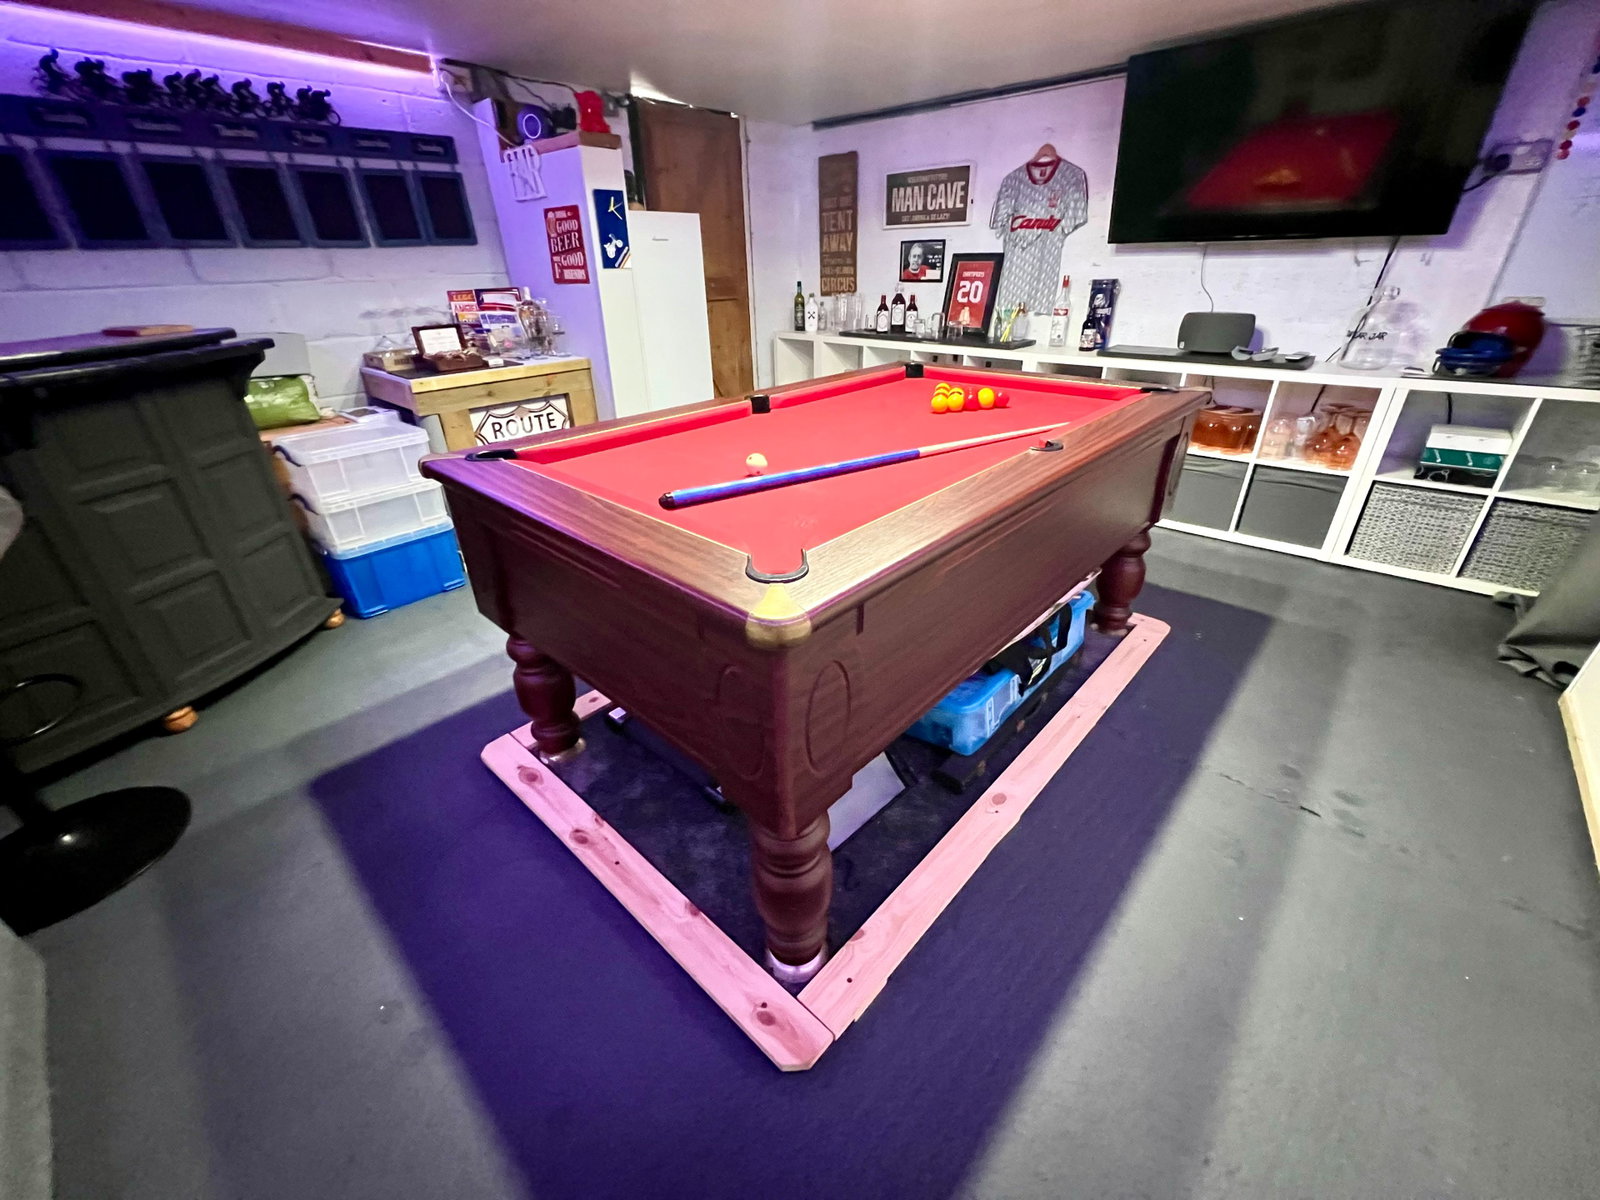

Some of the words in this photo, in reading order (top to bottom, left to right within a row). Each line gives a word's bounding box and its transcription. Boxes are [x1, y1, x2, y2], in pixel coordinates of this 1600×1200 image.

[892, 184, 924, 213] MAN
[927, 181, 966, 211] CAVE
[556, 219, 579, 234] GOOD
[822, 209, 853, 232] TENT
[1010, 215, 1062, 232] Candy
[550, 232, 580, 253] BEER
[822, 232, 854, 252] AWAY
[561, 252, 584, 267] GOOD
[821, 276, 856, 292] CIRCUS
[957, 280, 984, 304] 20
[1368, 331, 1388, 341] JAR
[491, 411, 557, 440] ROUTE
